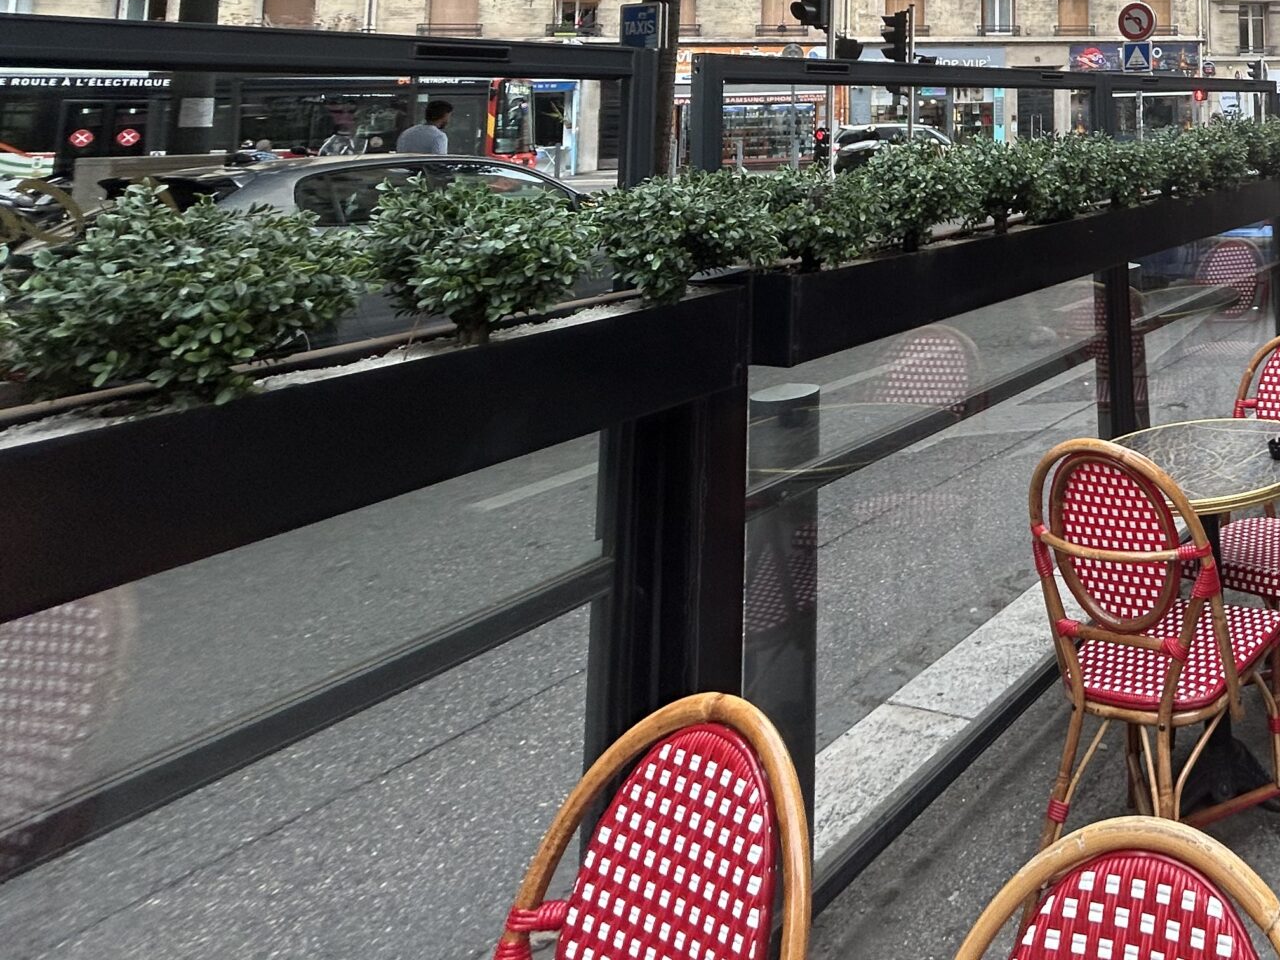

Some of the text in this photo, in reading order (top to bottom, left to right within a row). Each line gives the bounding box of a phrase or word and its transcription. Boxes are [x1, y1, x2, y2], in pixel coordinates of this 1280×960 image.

[624, 20, 655, 35] TAXIS
[11, 78, 58, 86] ROULE
[61, 77, 71, 86] À
[76, 77, 171, 86] L'ÉLECTRIQUE
